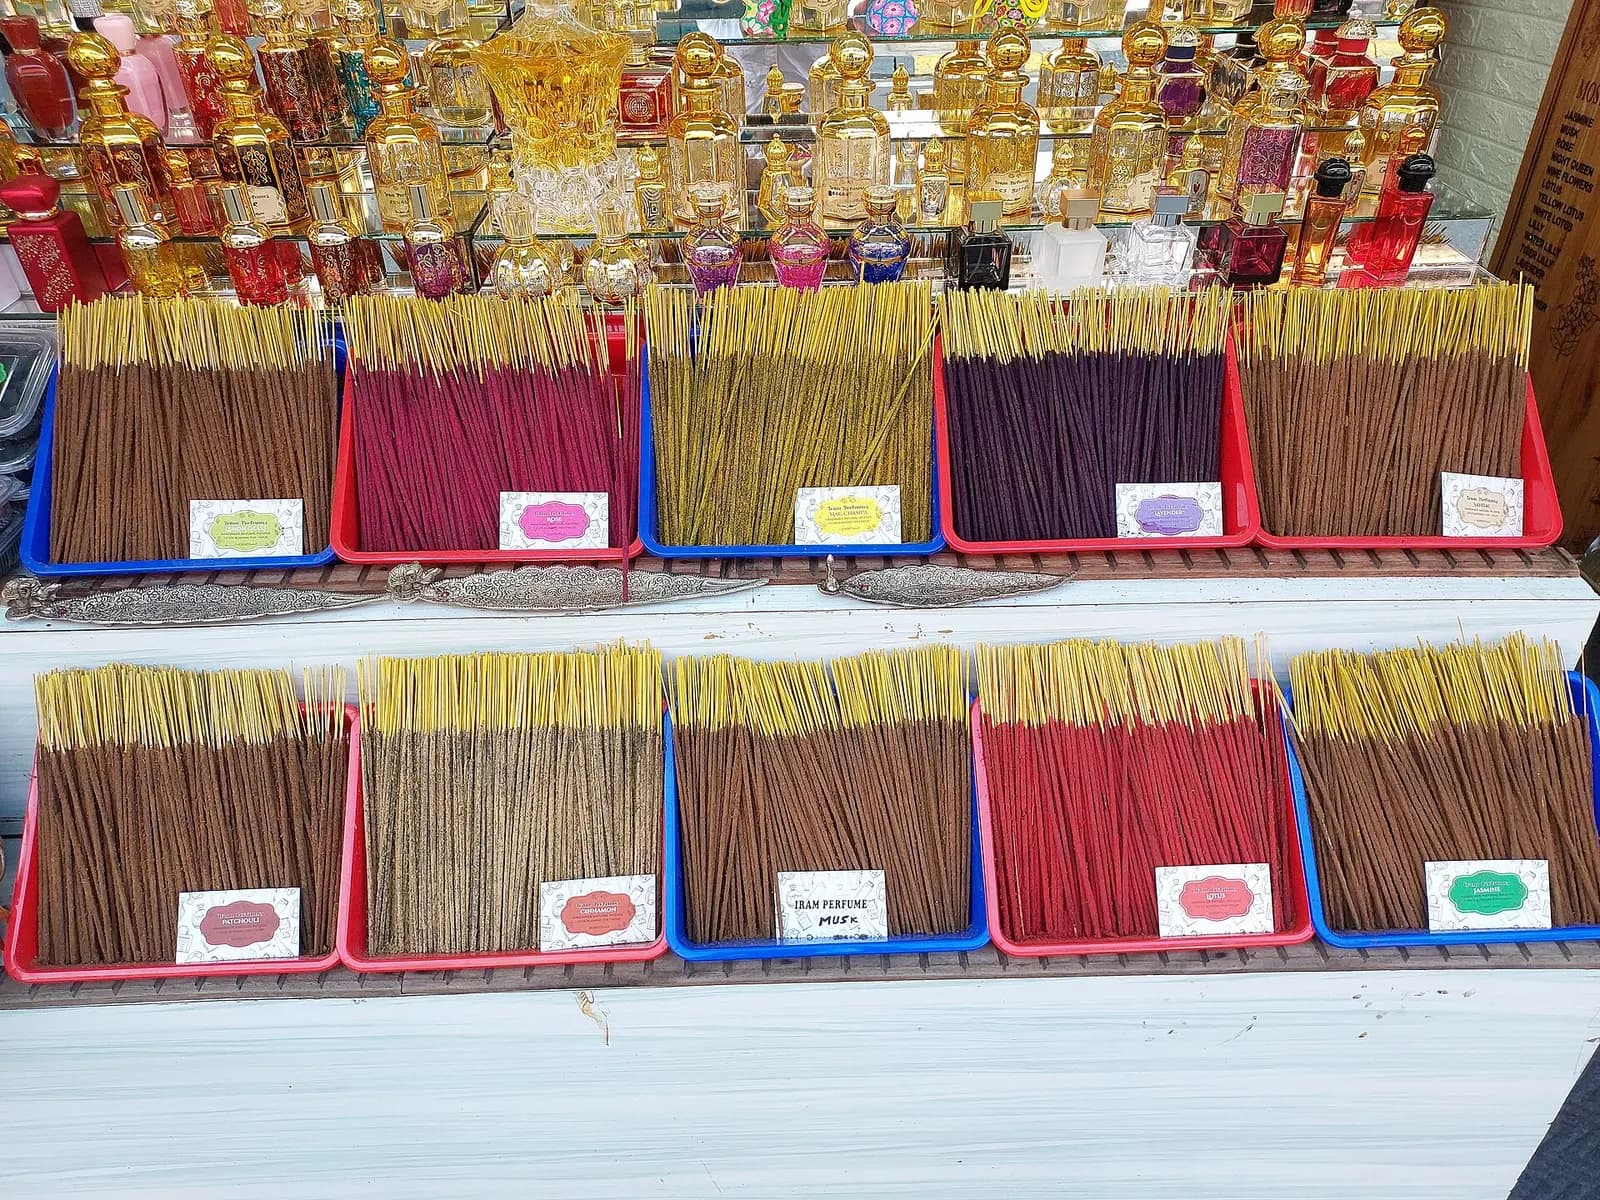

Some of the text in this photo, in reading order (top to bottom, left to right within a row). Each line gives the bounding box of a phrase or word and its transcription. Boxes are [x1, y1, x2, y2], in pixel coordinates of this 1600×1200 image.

[1565, 110, 1594, 128] JASMINE
[1560, 123, 1580, 138] MUSK
[1555, 137, 1575, 152] ROSE
[1551, 151, 1594, 177] NIGHT QUEEN
[1541, 178, 1563, 195] LOTUS
[1561, 171, 1594, 193] FLOWERS
[1538, 191, 1585, 222] YELLOW LOTUS
[1533, 205, 1574, 232] WHITE LOTUS
[1515, 255, 1546, 281] LAVENDER
[1473, 887, 1501, 895] JASMINE
[579, 906, 617, 915] CINNAMON
[794, 899, 868, 909] IRAM PERFUME
[222, 917, 260, 926] PATCHOULI
[818, 914, 858, 927] MUSK
